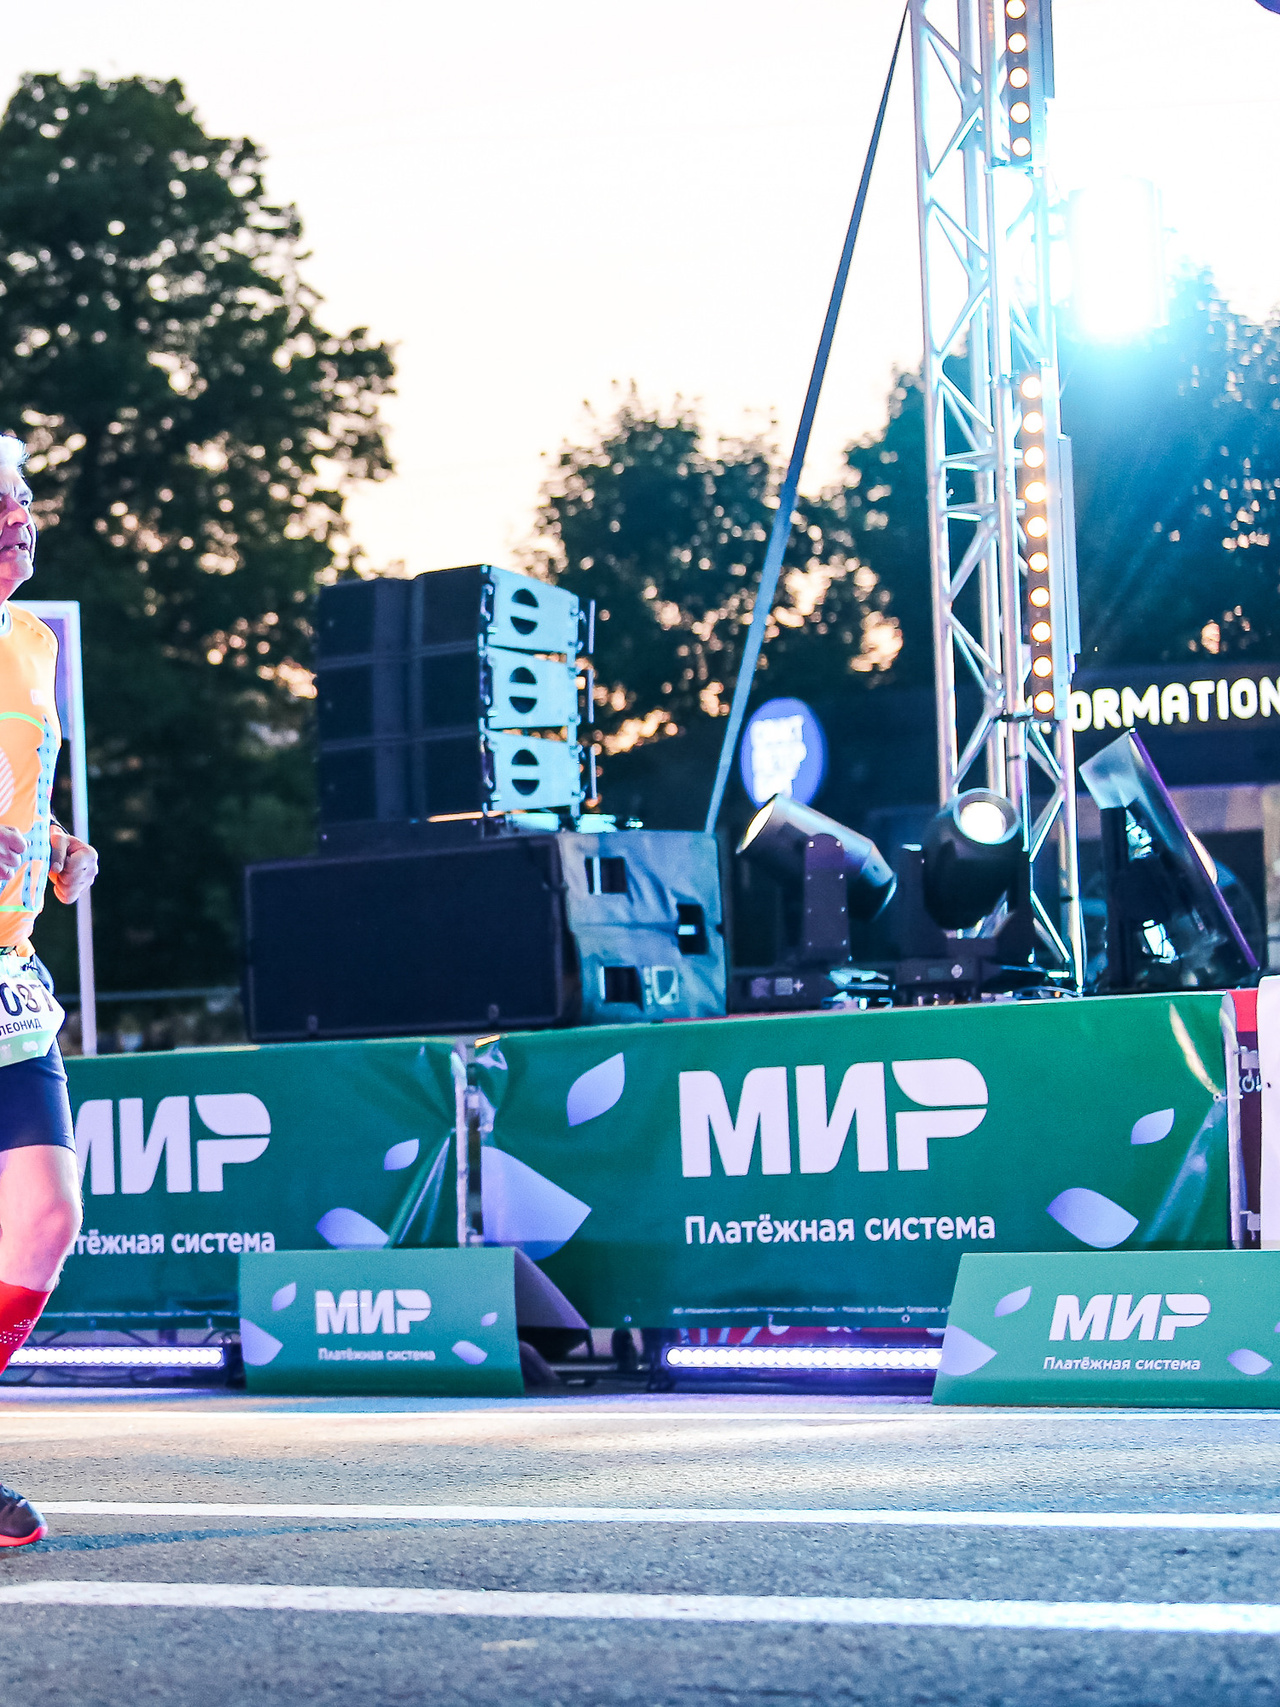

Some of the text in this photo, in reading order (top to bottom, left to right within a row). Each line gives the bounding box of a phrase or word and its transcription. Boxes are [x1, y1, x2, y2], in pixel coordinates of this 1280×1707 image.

[1069, 676, 1280, 731] ORMATION
[678, 1058, 989, 1178] МИР
[62, 1229, 276, 1255] тёжная система
[685, 1213, 996, 1244] Платёжная система
[315, 1289, 432, 1334] МИР
[1049, 1293, 1212, 1341] МИР
[1043, 1356, 1202, 1371] Платёжная система
